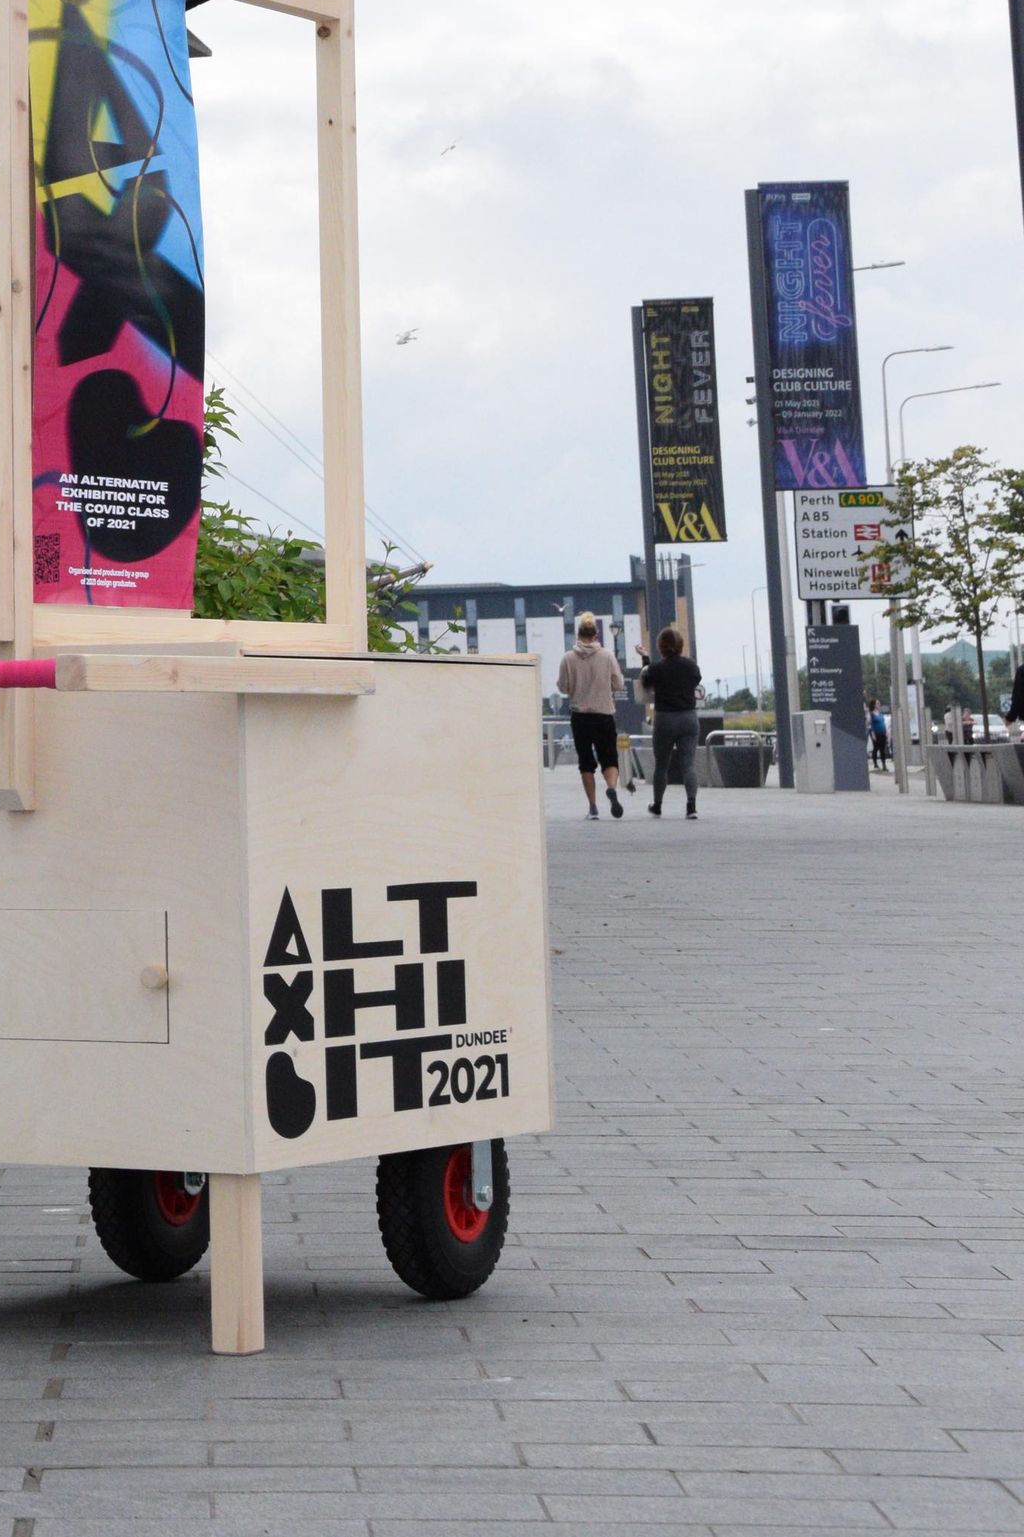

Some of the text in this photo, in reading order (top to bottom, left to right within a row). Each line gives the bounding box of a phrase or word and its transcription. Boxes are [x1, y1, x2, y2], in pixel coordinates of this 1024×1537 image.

[775, 215, 808, 344] NIGHT
[650, 331, 674, 425] NIGHT
[690, 330, 714, 423] FEVER
[772, 368, 834, 379] DESIGNING
[773, 380, 852, 392] CLUB CULTURE
[785, 400, 801, 409] May
[794, 410, 823, 419] January
[825, 409, 842, 417] 2022
[653, 446, 701, 455] DESIGNING
[653, 456, 715, 465] CLUB CULTURE
[778, 438, 866, 488] V&A
[59, 473, 169, 492] AN ALTERNATIVE
[61, 487, 166, 505] EXHIBITION FOR
[800, 495, 834, 505] Perth
[56, 501, 170, 519] THE COVID CLASS
[87, 517, 136, 530] OF 2021
[658, 502, 723, 541] V&A
[802, 528, 848, 539] Station
[802, 549, 847, 560] Airport
[93, 568, 102, 576] and
[102, 569, 125, 578] produced
[135, 572, 149, 580] group
[804, 567, 862, 578] Ninewell
[809, 580, 861, 592] Hospital
[263, 880, 478, 967] ALT
[455, 1030, 507, 1049] DUNDEE
[427, 1053, 510, 1107] 2021
